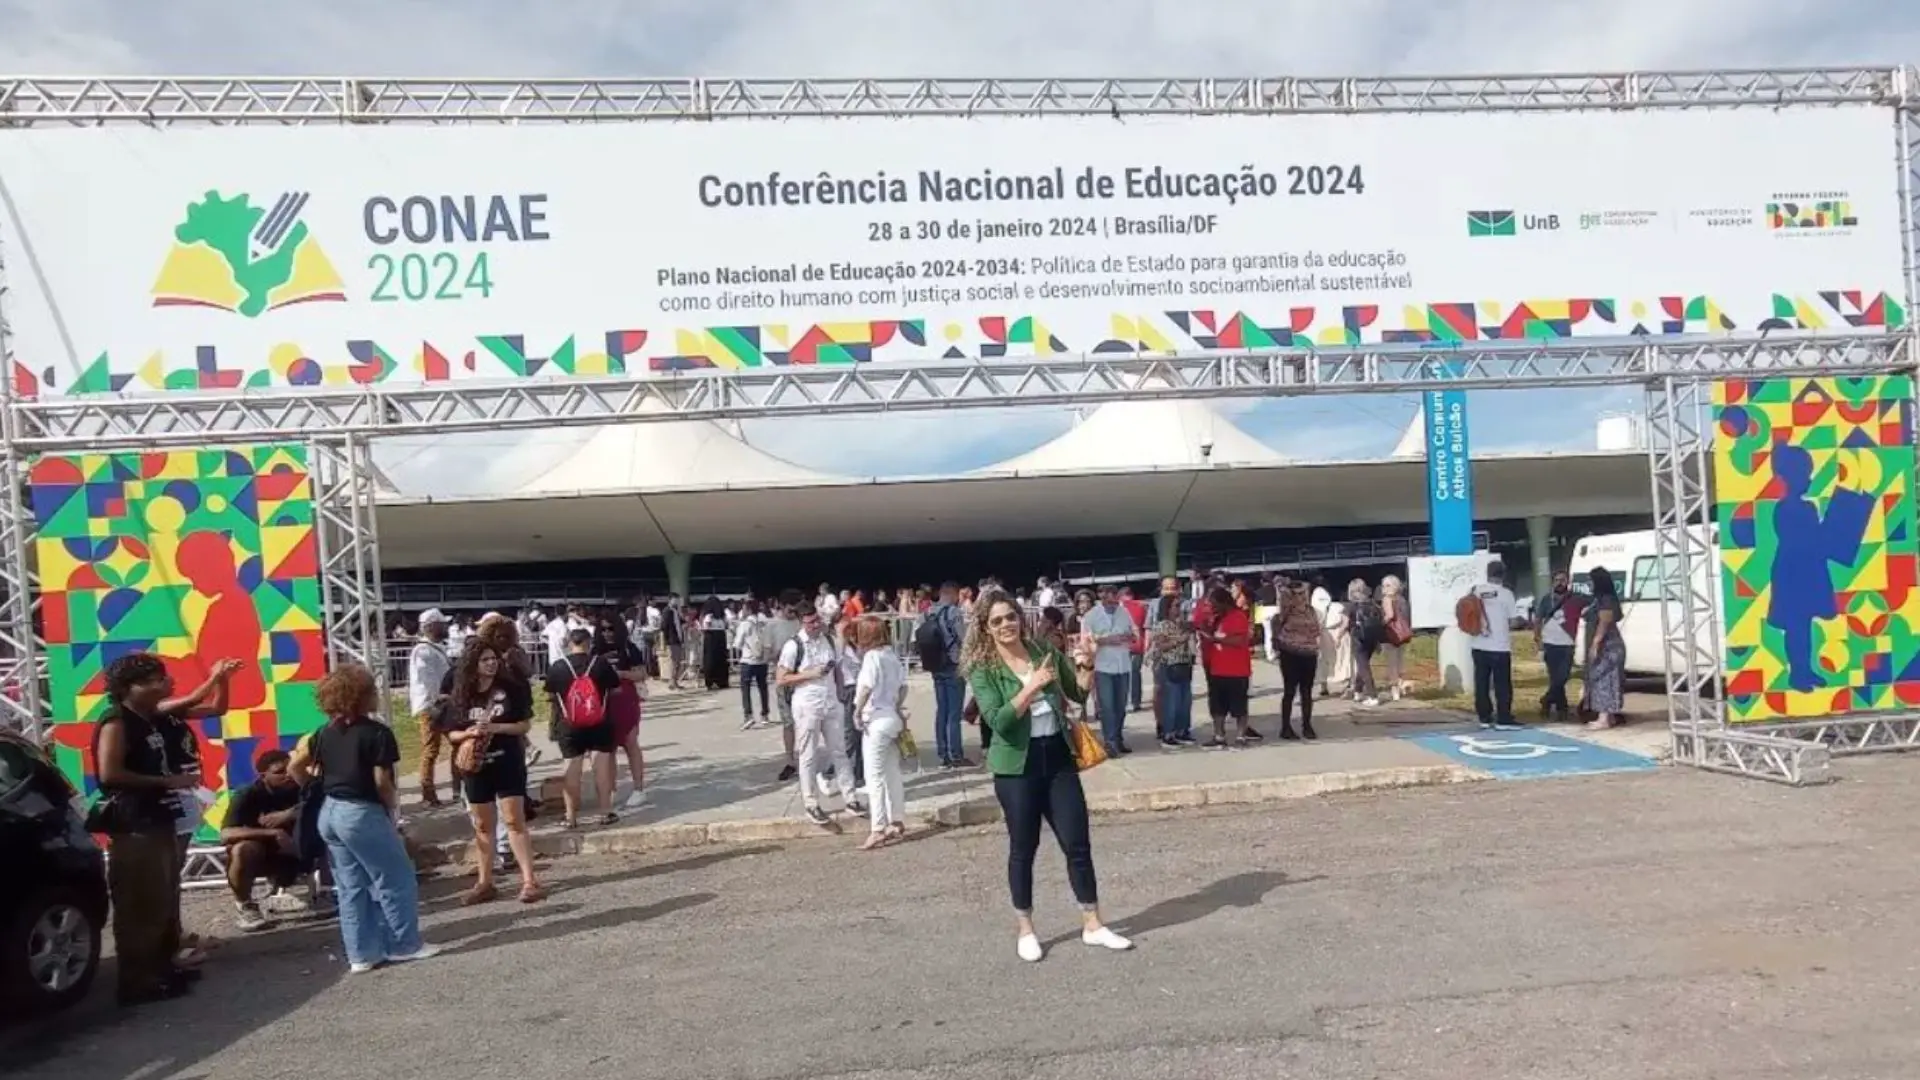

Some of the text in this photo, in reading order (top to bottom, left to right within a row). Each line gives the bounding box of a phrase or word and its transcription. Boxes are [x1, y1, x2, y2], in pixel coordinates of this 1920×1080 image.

[698, 163, 1366, 207] Conferência Nacional de Educação 2024
[364, 193, 551, 246] CONAE
[868, 221, 893, 242] 28
[899, 225, 911, 241] a
[916, 220, 941, 240] 30
[946, 218, 972, 240] de
[976, 217, 1044, 244] janeiro
[1048, 215, 1098, 237] 2024
[1114, 212, 1219, 237] Brasília/DF
[1523, 214, 1561, 231] UnB
[367, 251, 495, 302] 2024
[656, 248, 1407, 288] Plano Nacional de Educação 2024-2034: Política de Estado para garantia da educação
[658, 272, 1414, 312] como direito humano com justiça social e desenvolvimento socioambiental sustentável
[1435, 450, 1449, 500] Centro
[1451, 457, 1466, 499] Athos
